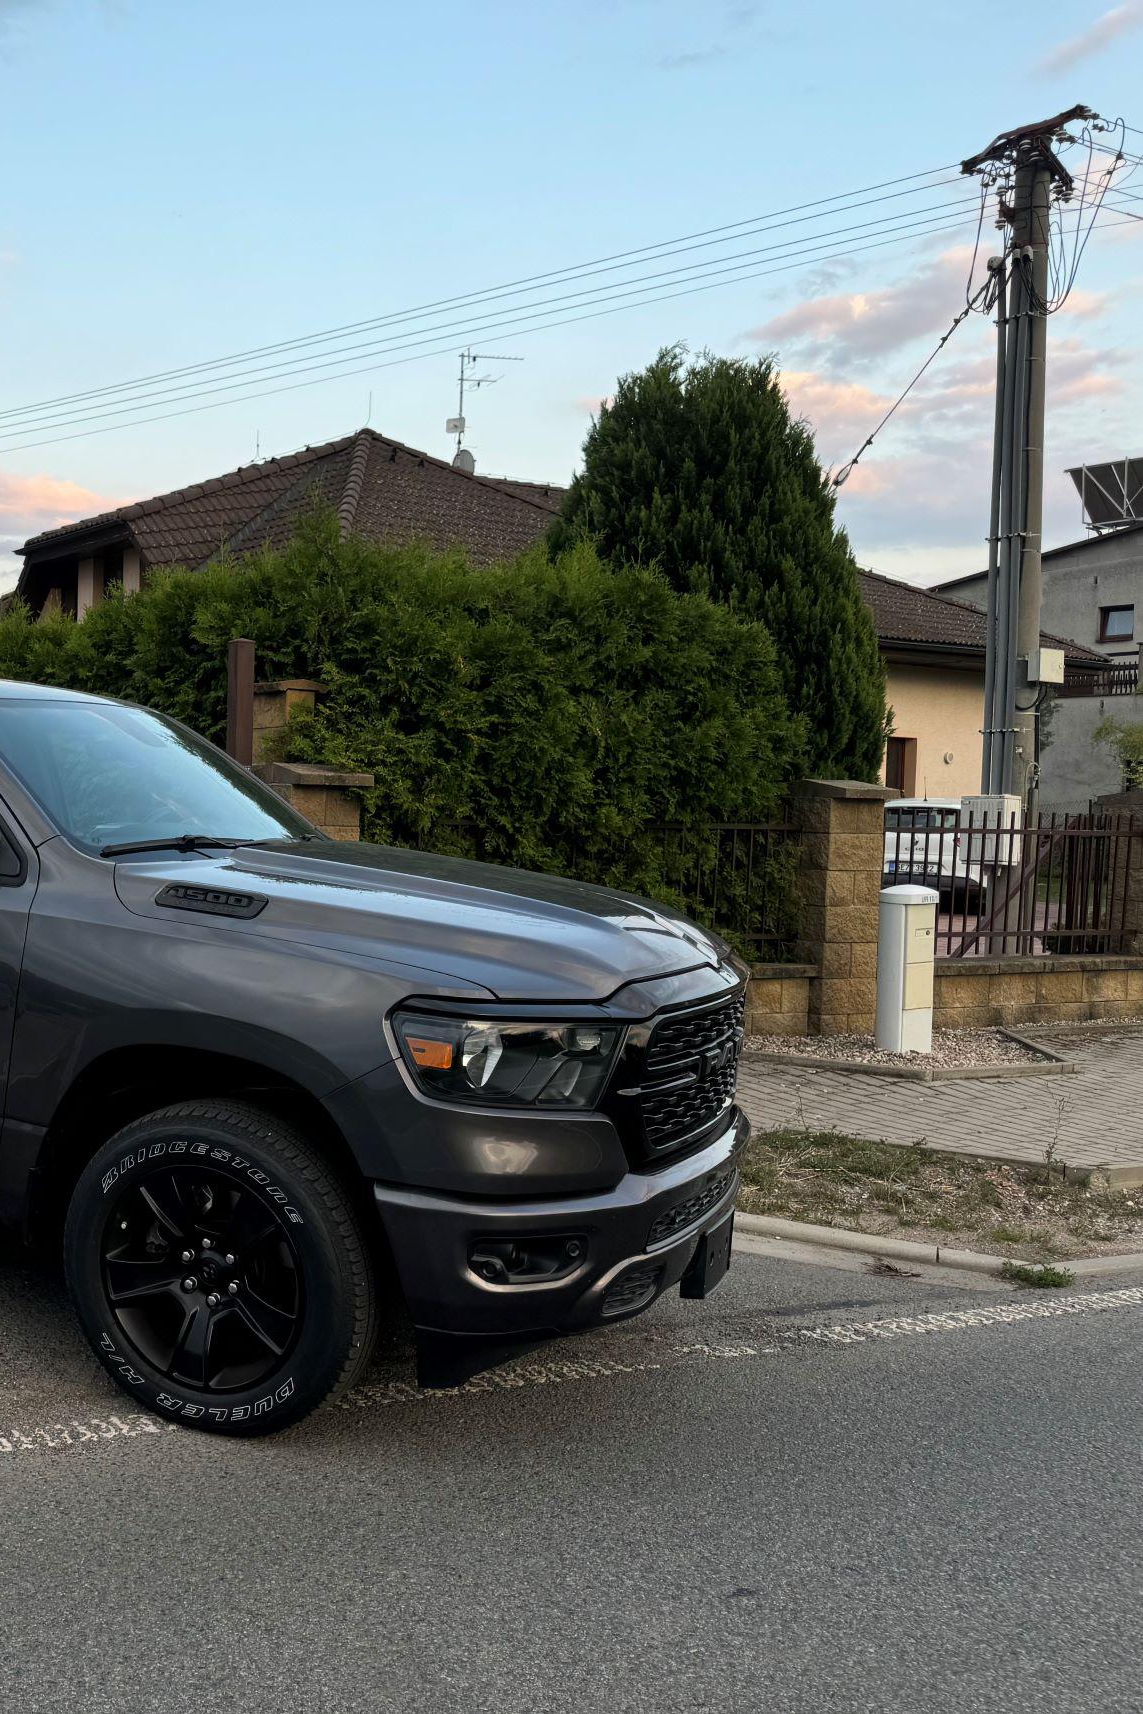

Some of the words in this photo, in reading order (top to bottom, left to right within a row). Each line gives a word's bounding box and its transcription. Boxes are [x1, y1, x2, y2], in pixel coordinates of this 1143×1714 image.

[166, 886, 254, 908] 1500
[101, 1141, 304, 1224] BRIDGESTONE
[101, 1332, 145, 1385] H/L
[156, 1377, 296, 1422] DUELER
